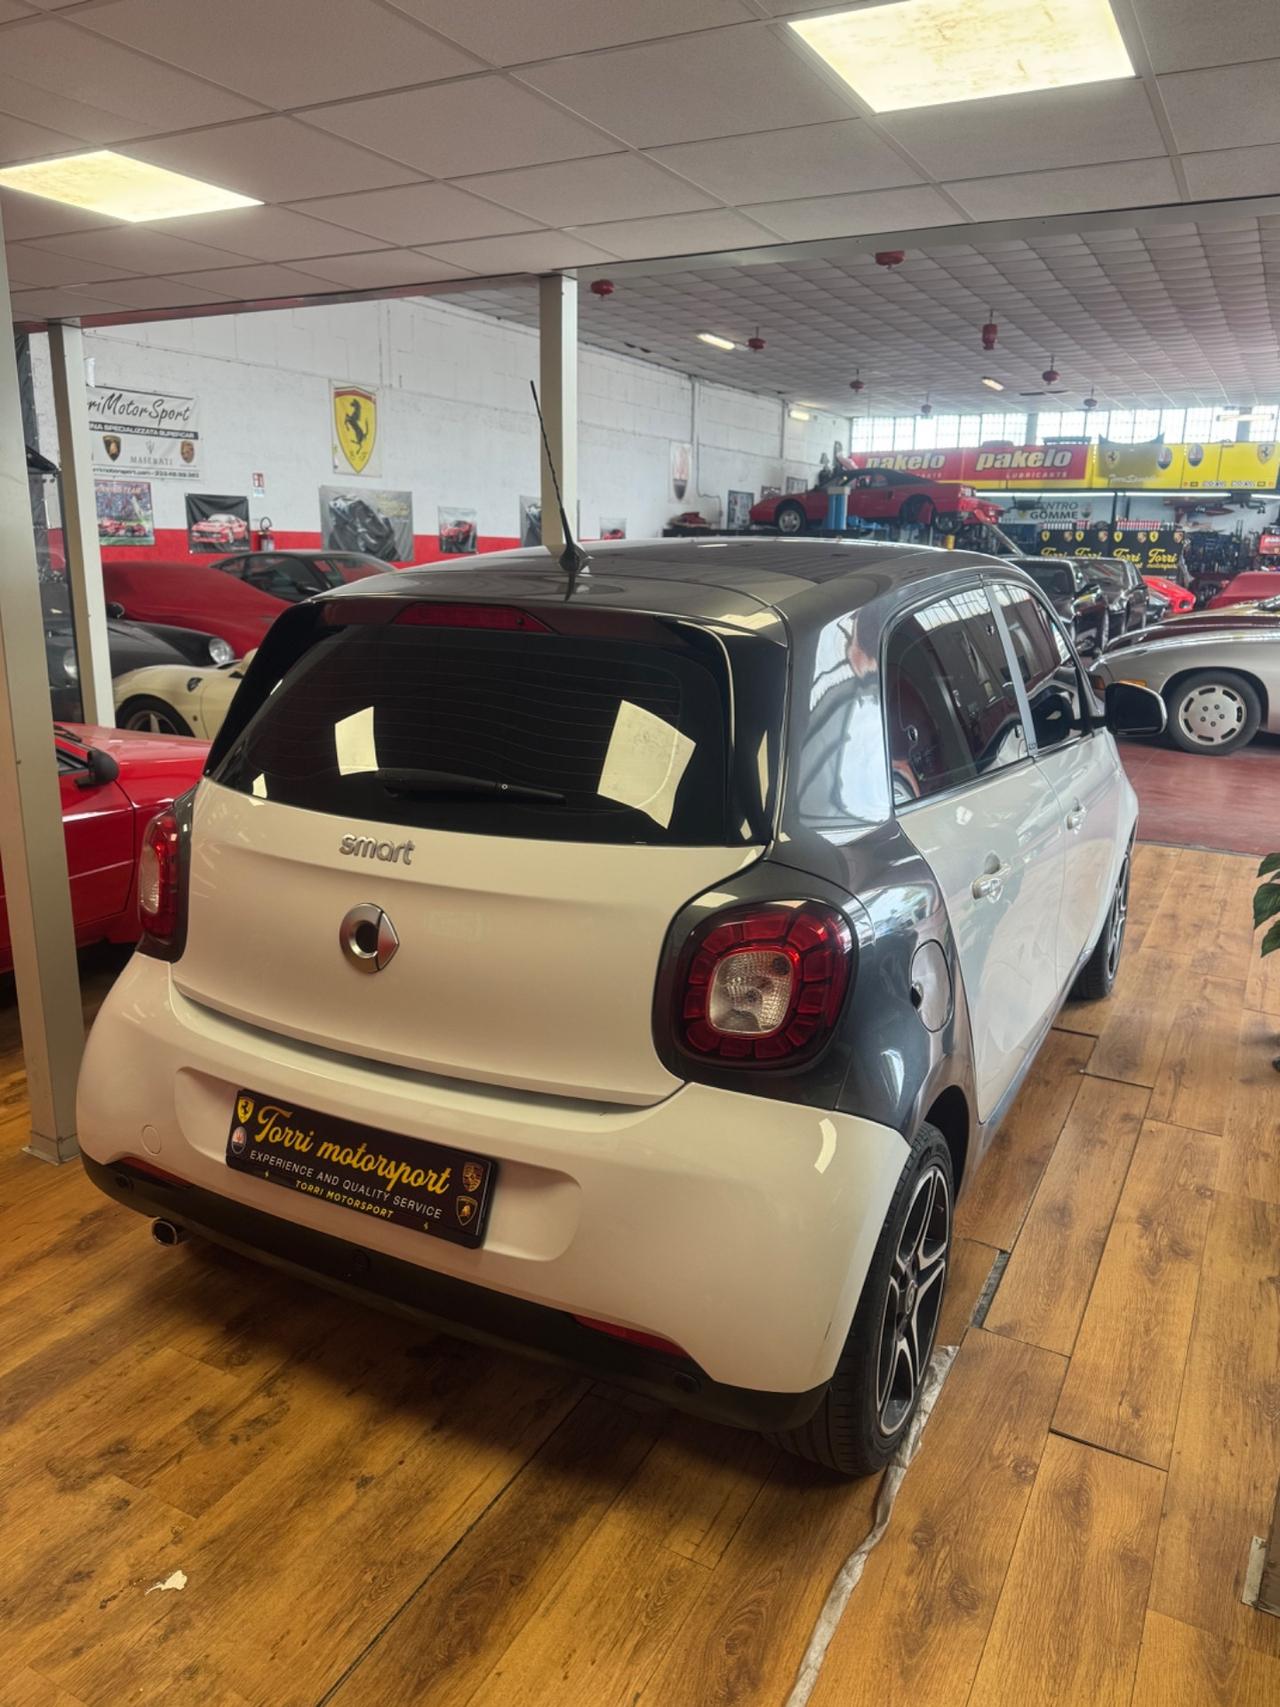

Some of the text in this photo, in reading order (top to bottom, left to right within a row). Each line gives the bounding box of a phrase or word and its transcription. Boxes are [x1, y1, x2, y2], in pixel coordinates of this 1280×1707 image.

[976, 449, 1072, 471] pakelo
[1030, 511, 1079, 520] GOMME
[1148, 548, 1177, 563] Torri
[339, 832, 415, 866] smart
[254, 1106, 452, 1194] Torri motorsport
[250, 1149, 443, 1220] EXPERIENCE AND QUALITY SERVICE
[295, 1179, 394, 1219] TORRI MOTORSPORT
